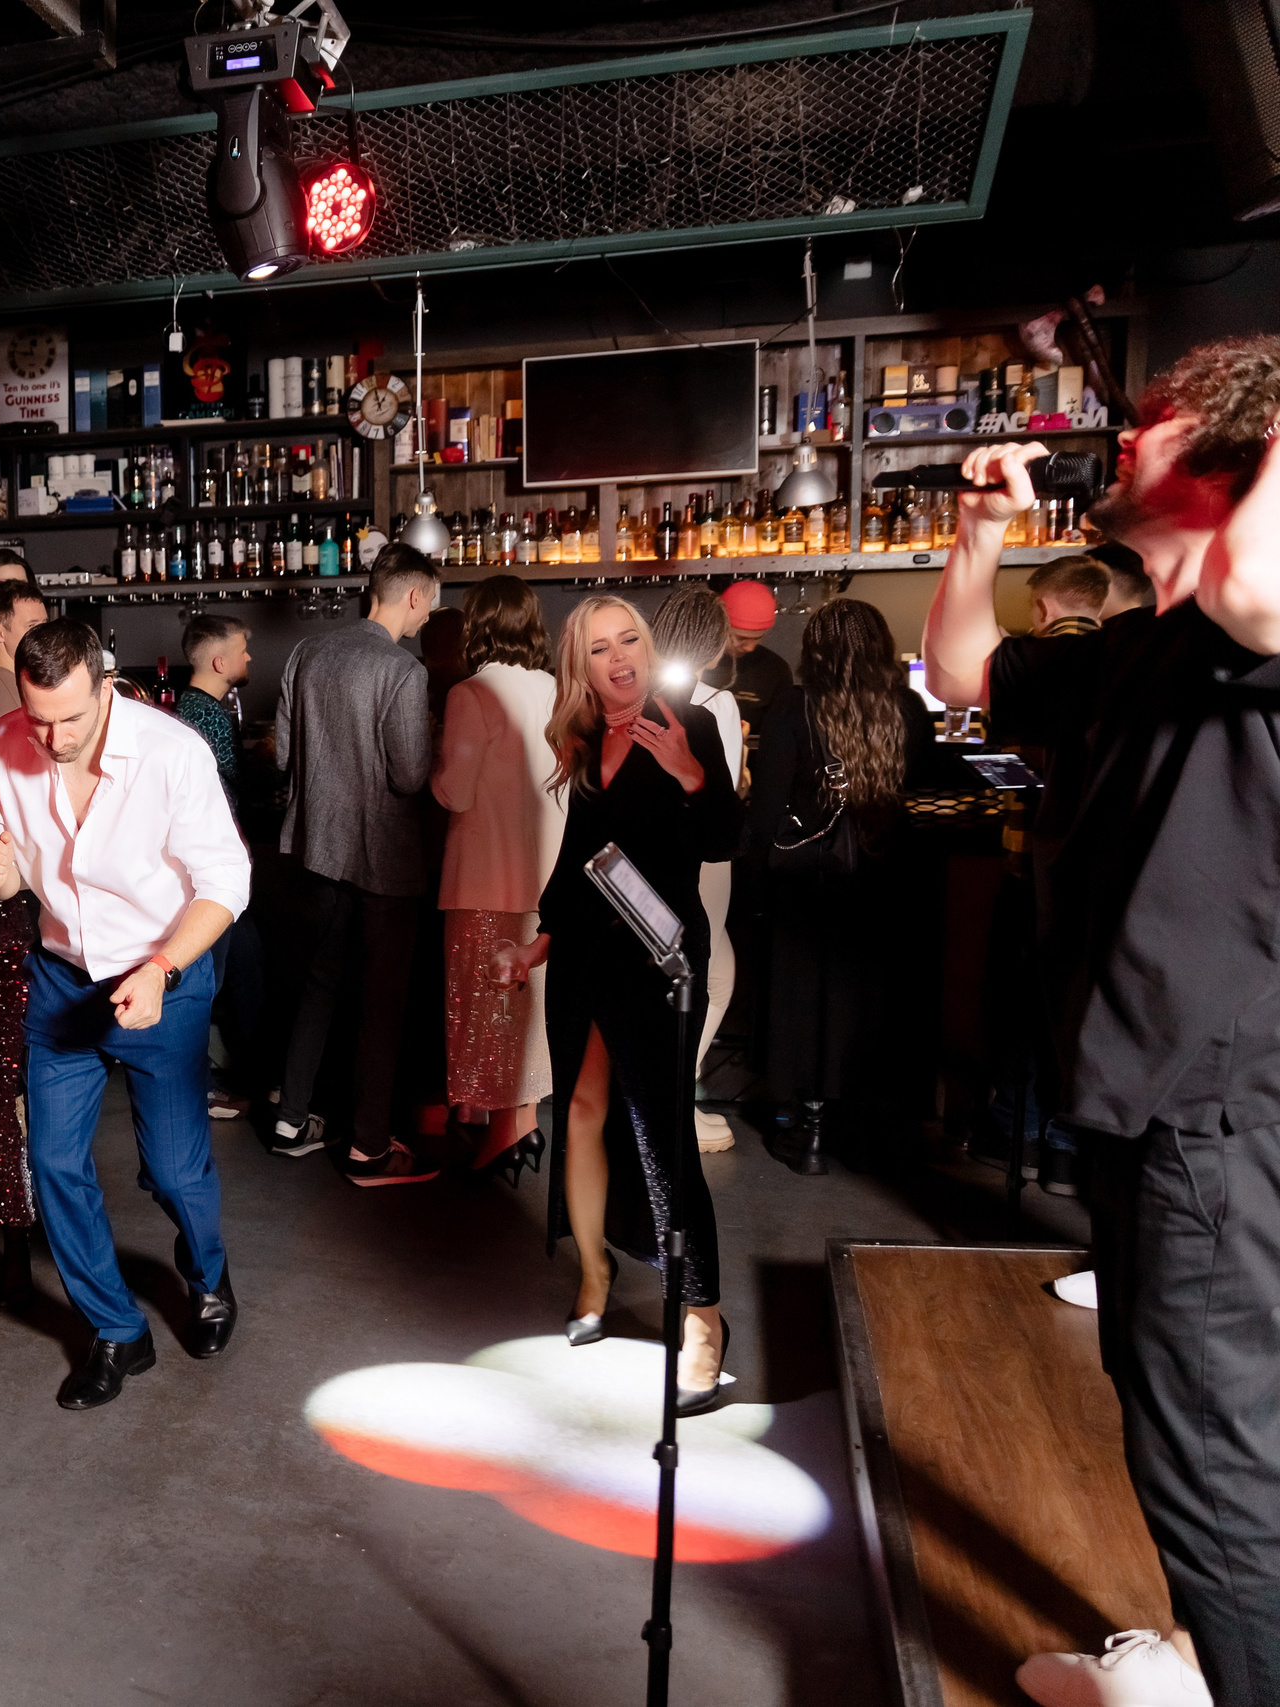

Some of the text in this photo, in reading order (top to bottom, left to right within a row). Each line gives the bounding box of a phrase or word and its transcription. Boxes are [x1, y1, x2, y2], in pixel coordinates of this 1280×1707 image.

[3, 383, 18, 393] Ten
[20, 383, 29, 391] to
[32, 381, 46, 391] one
[5, 393, 60, 406] GUINNESS
[19, 407, 45, 419] TIME
